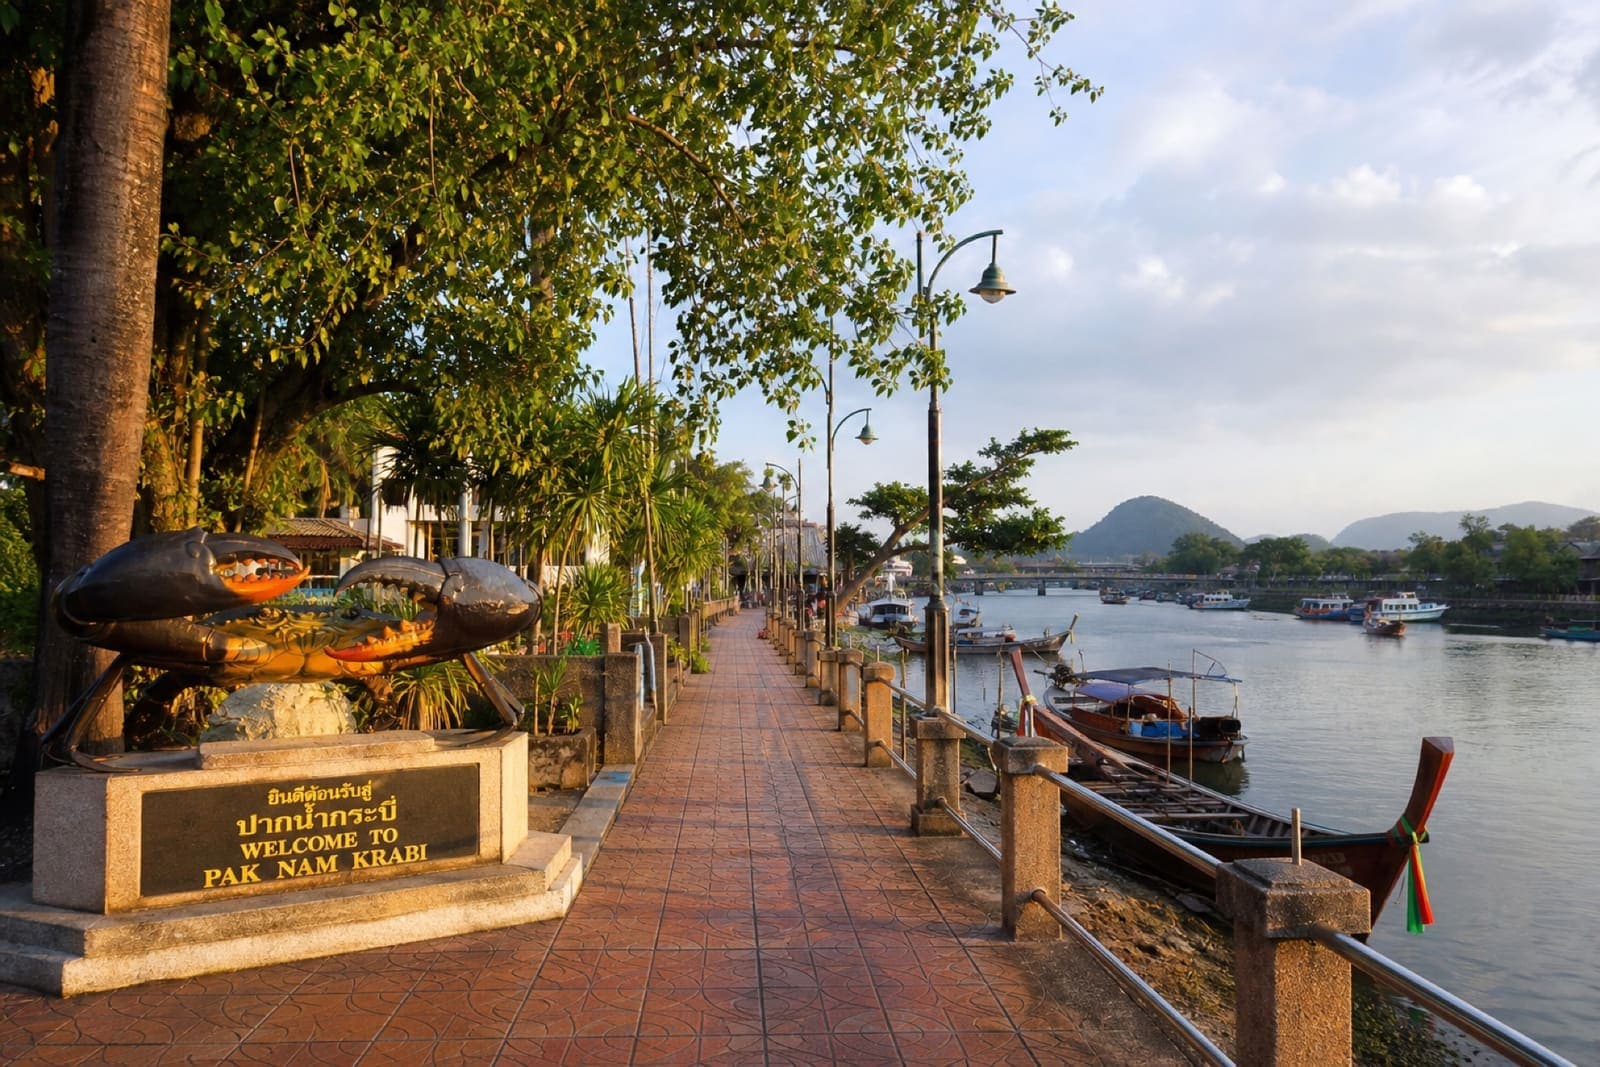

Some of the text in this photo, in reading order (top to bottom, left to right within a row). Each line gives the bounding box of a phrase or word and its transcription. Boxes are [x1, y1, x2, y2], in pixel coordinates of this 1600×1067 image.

[267, 779, 373, 806] ยินดีต้อนรับสู่
[236, 795, 398, 837] ปากน้ำกระบี่
[240, 828, 398, 860] WELCOME TO
[203, 843, 428, 889] PAK NAM KRABI
